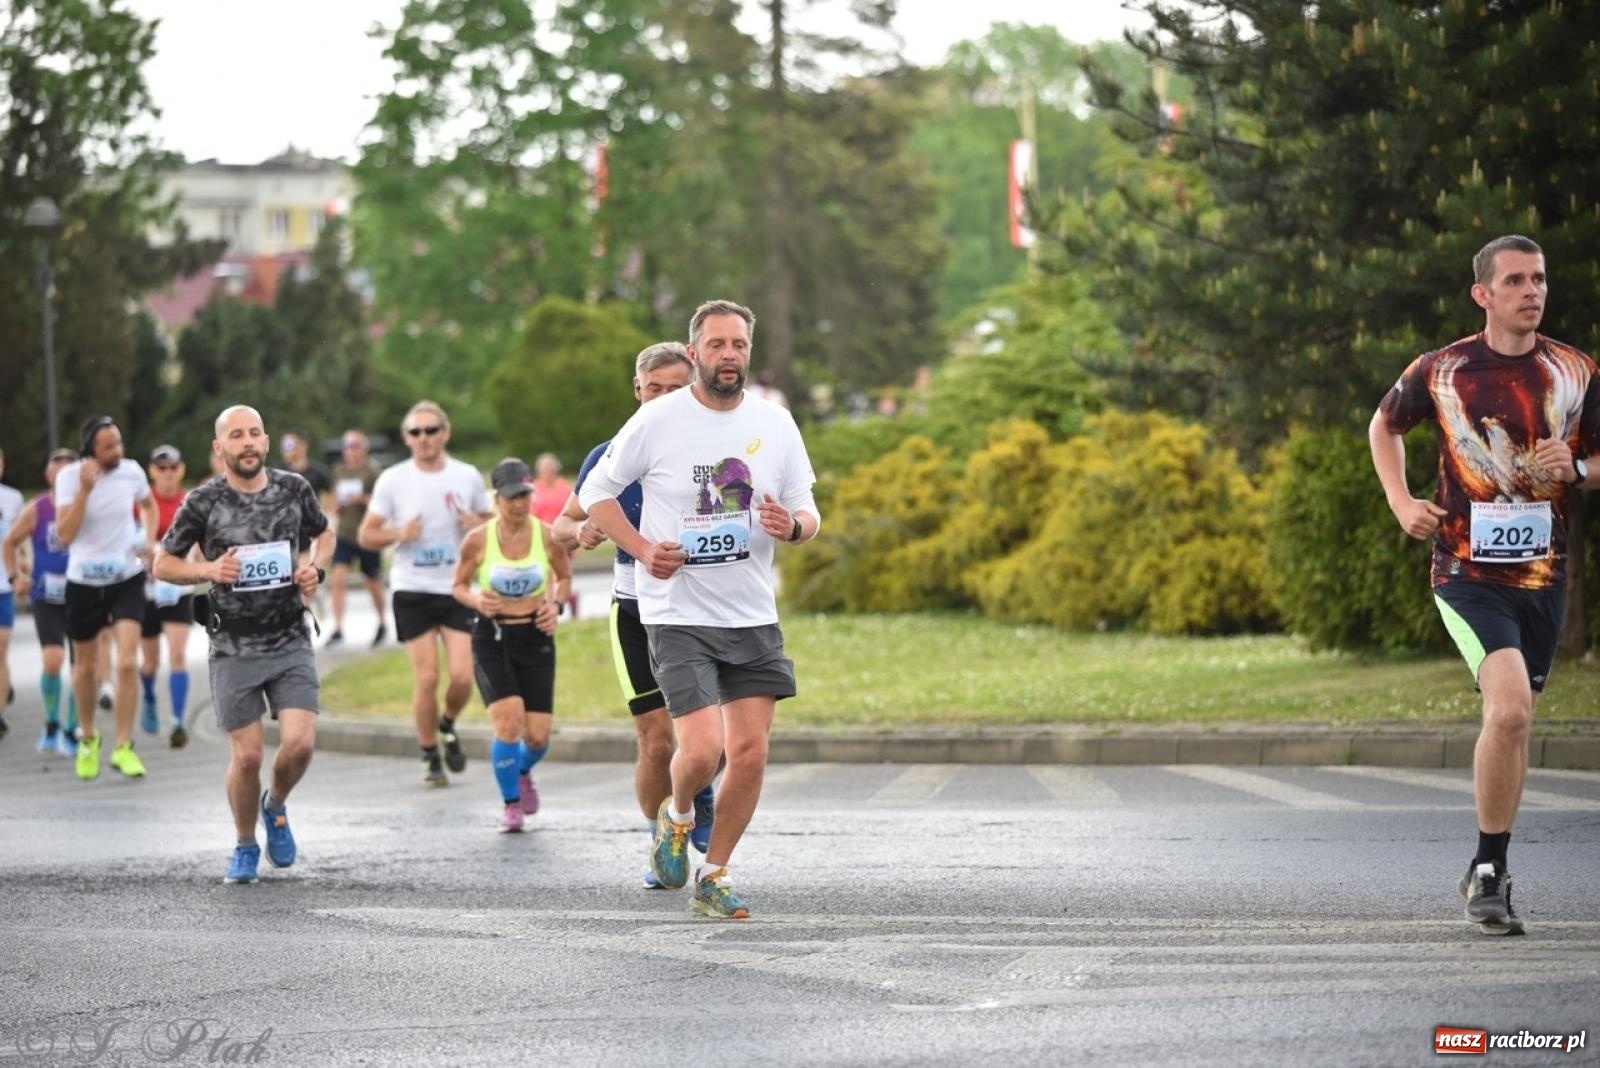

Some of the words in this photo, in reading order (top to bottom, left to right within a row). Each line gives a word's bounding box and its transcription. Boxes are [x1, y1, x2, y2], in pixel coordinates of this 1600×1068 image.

[697, 534, 735, 553] 259
[1492, 527, 1534, 546] 202
[245, 561, 279, 579] 266
[504, 580, 530, 592] 157
